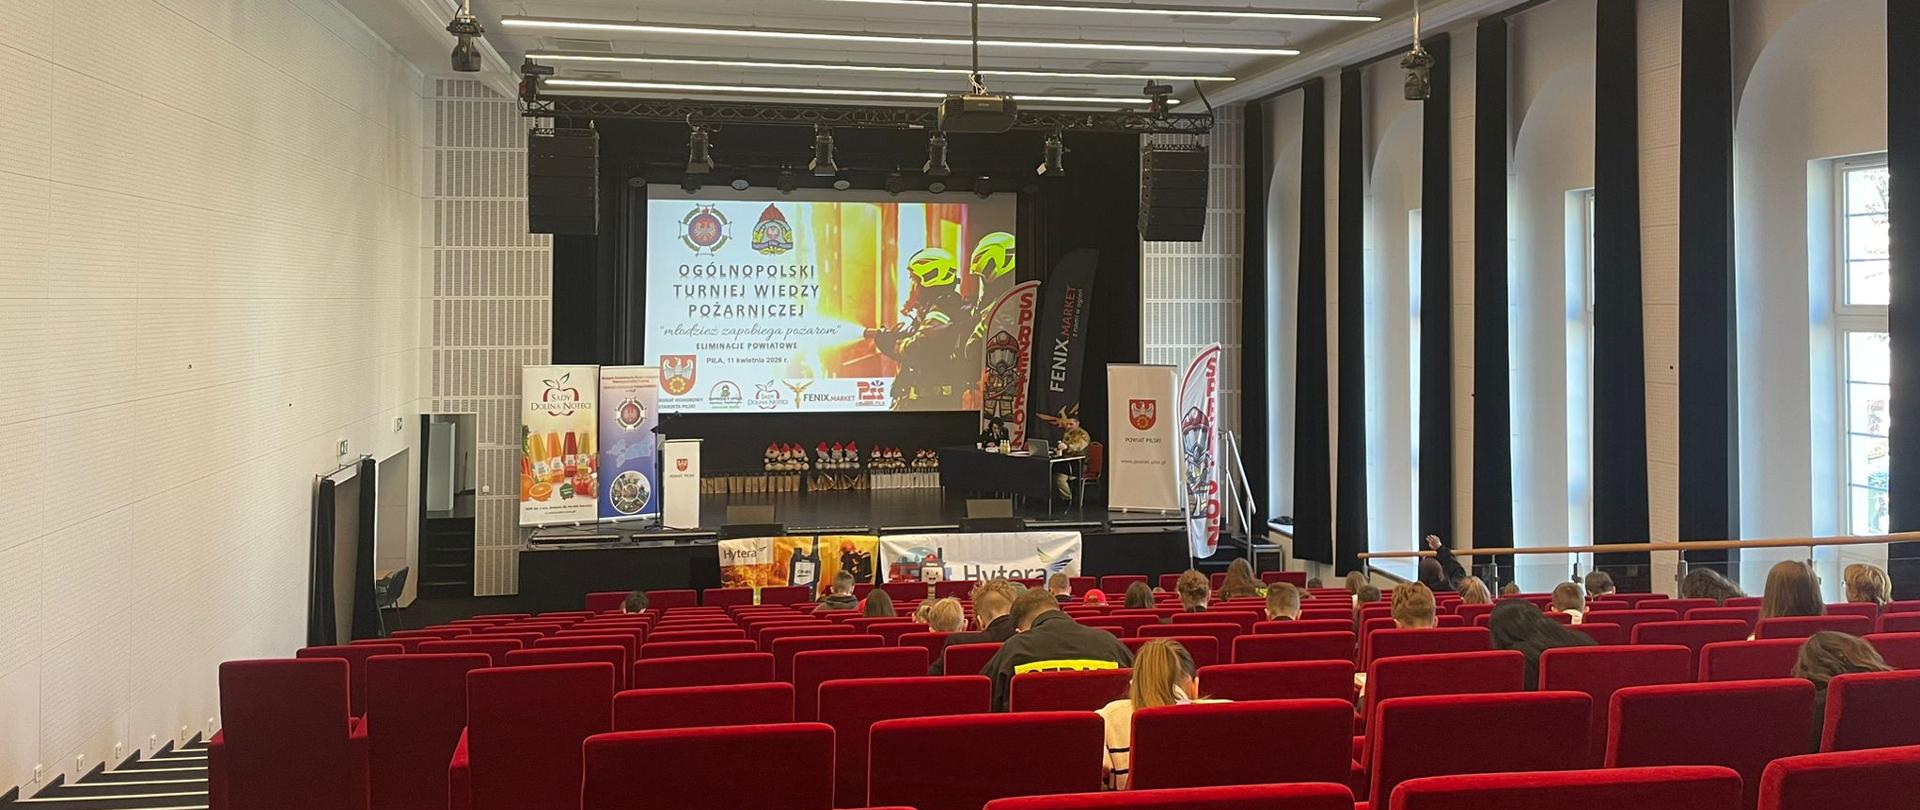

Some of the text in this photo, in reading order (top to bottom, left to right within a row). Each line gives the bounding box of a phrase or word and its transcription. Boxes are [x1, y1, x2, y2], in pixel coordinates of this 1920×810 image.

[679, 261, 815, 278] OGÓLNOPOLSKI
[673, 284, 819, 298] TURNIEJ WIEDZY
[688, 301, 804, 317] POŻARNICZEJ
[721, 322, 783, 340] zapobiega
[696, 342, 797, 350] ELIMINACJE POWIATOWE
[530, 402, 561, 411] DOLINA
[723, 549, 757, 560] Hytera
